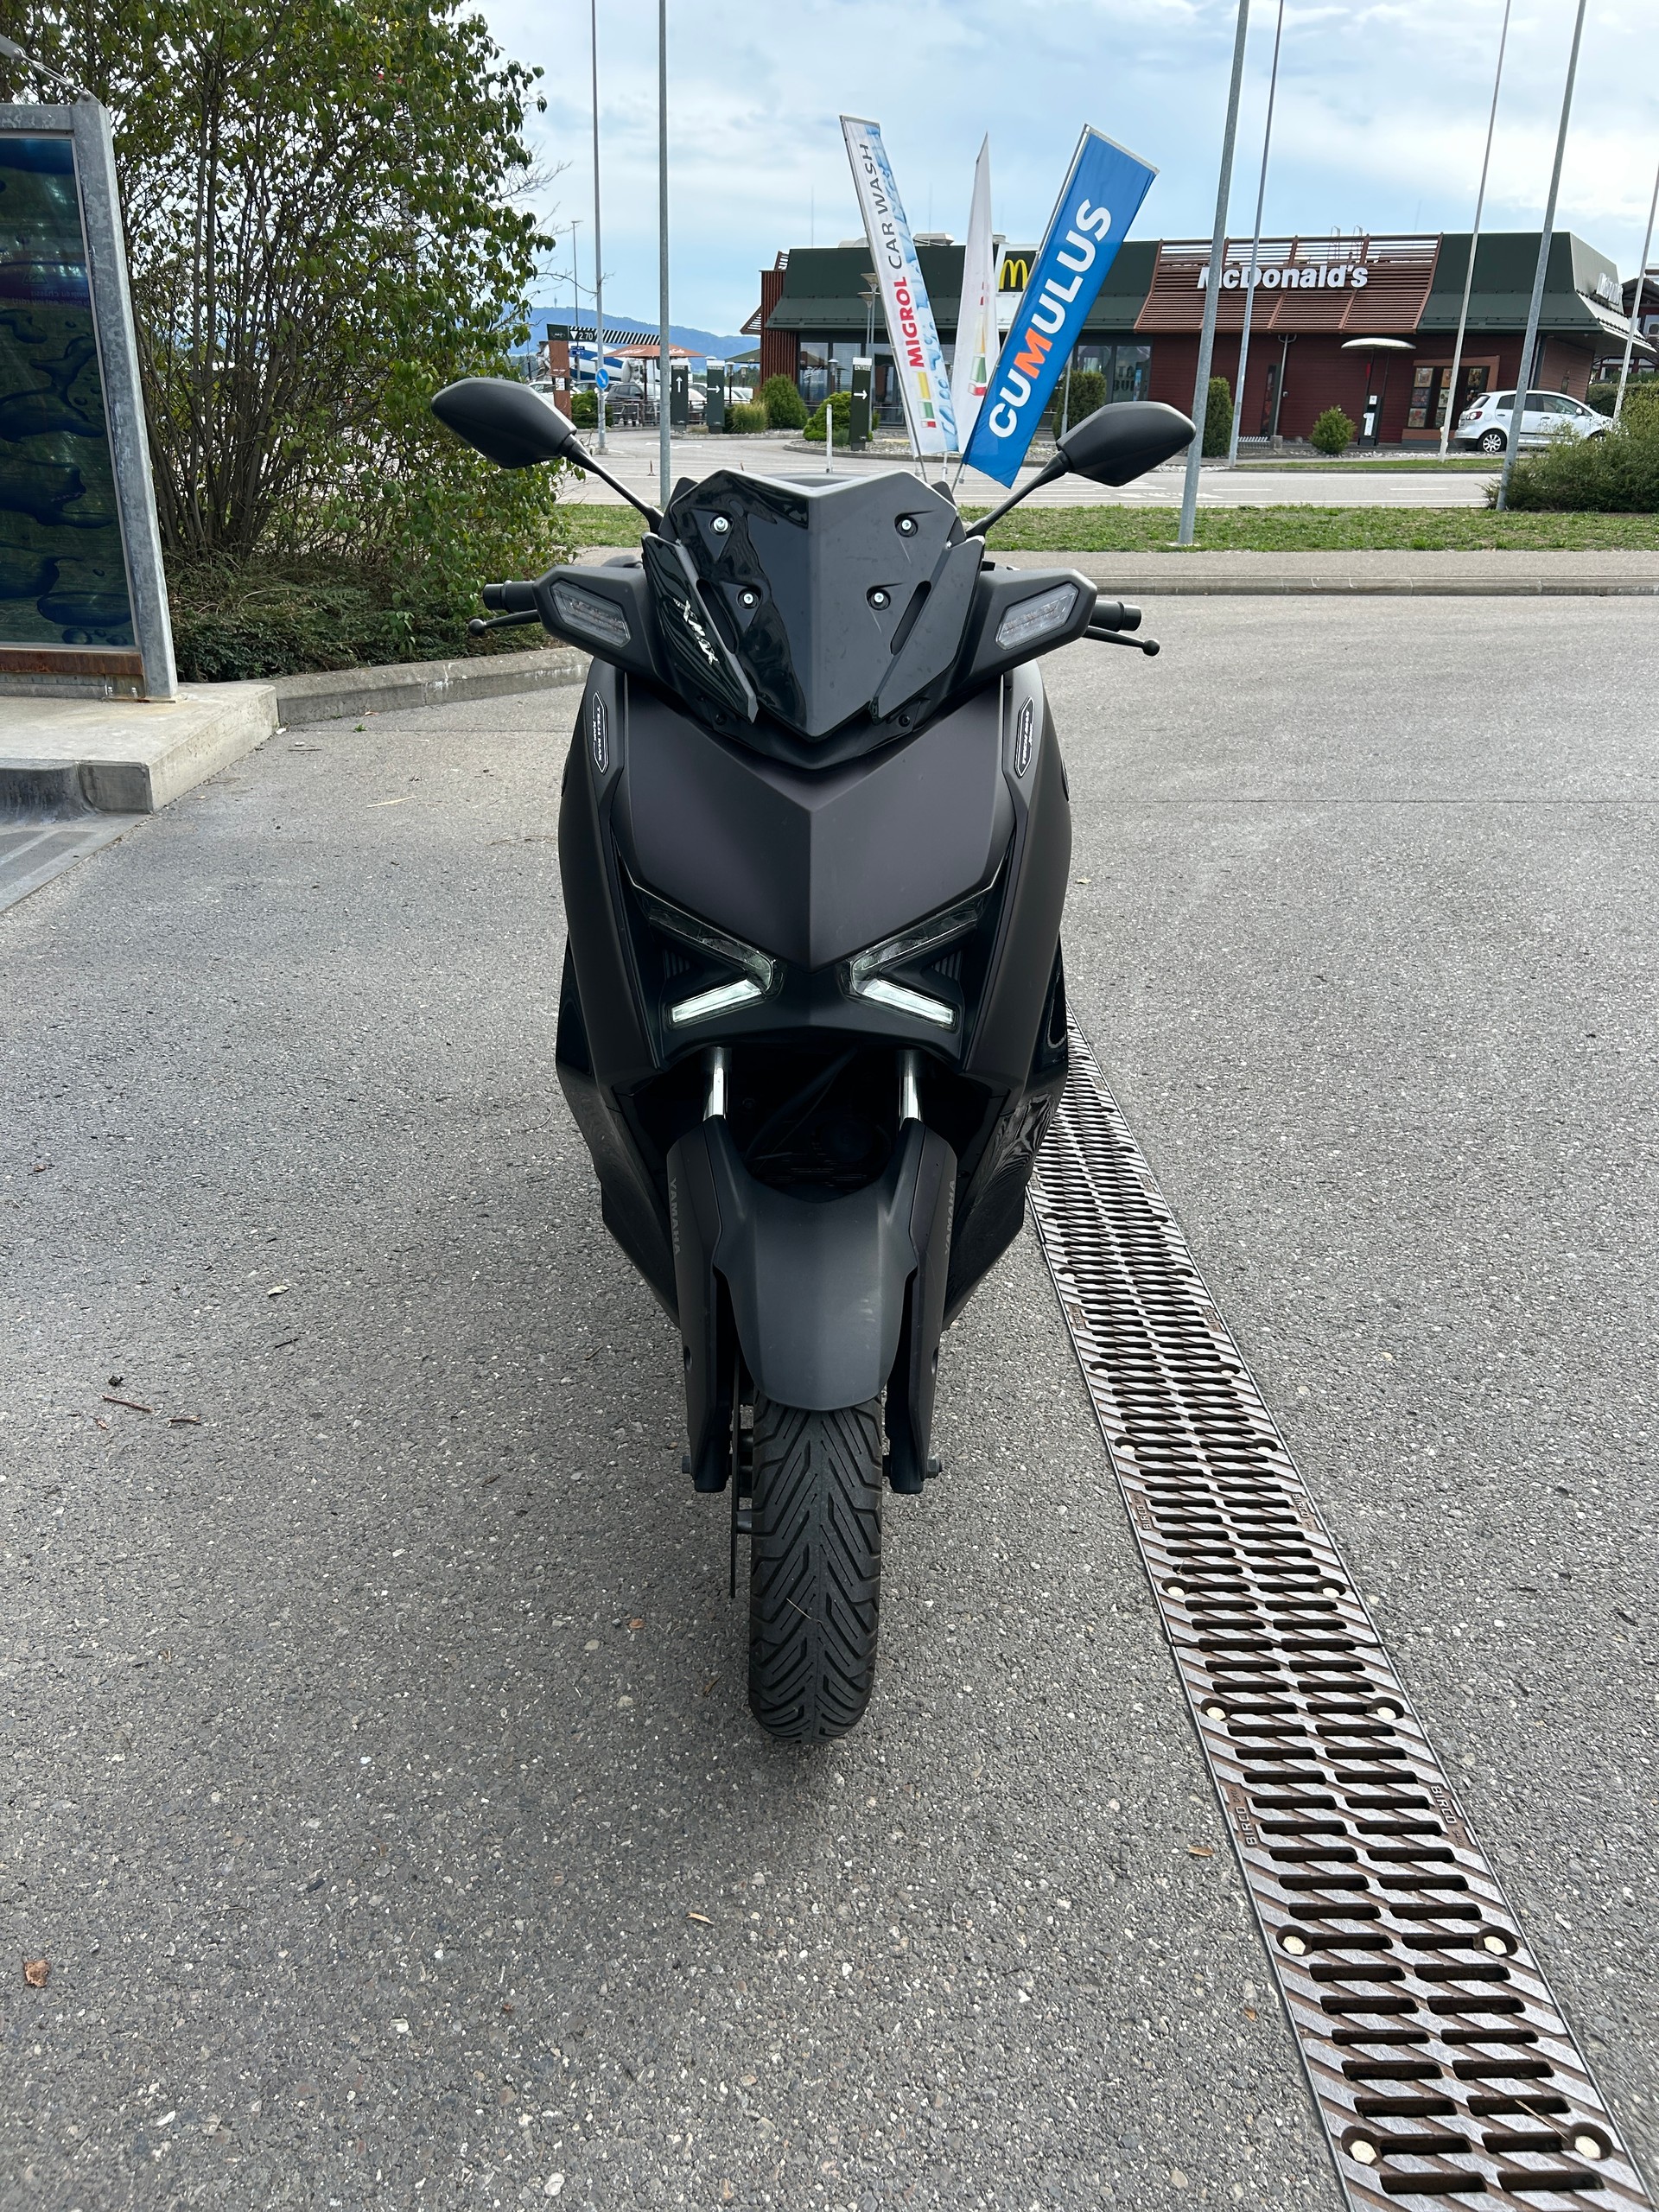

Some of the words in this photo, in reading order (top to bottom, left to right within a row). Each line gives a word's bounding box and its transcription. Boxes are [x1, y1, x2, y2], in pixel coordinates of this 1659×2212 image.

[859, 143, 888, 216] WASH
[881, 222, 903, 270] CAR
[893, 276, 925, 368] MIGROL
[988, 199, 1112, 438] CUMULUS
[670, 1177, 681, 1255] YAMAHA
[1136, 1504, 1152, 1530] BIRCO
[1235, 1806, 1257, 1846] BIRCO
[1430, 1785, 1458, 1825] BIRCO
